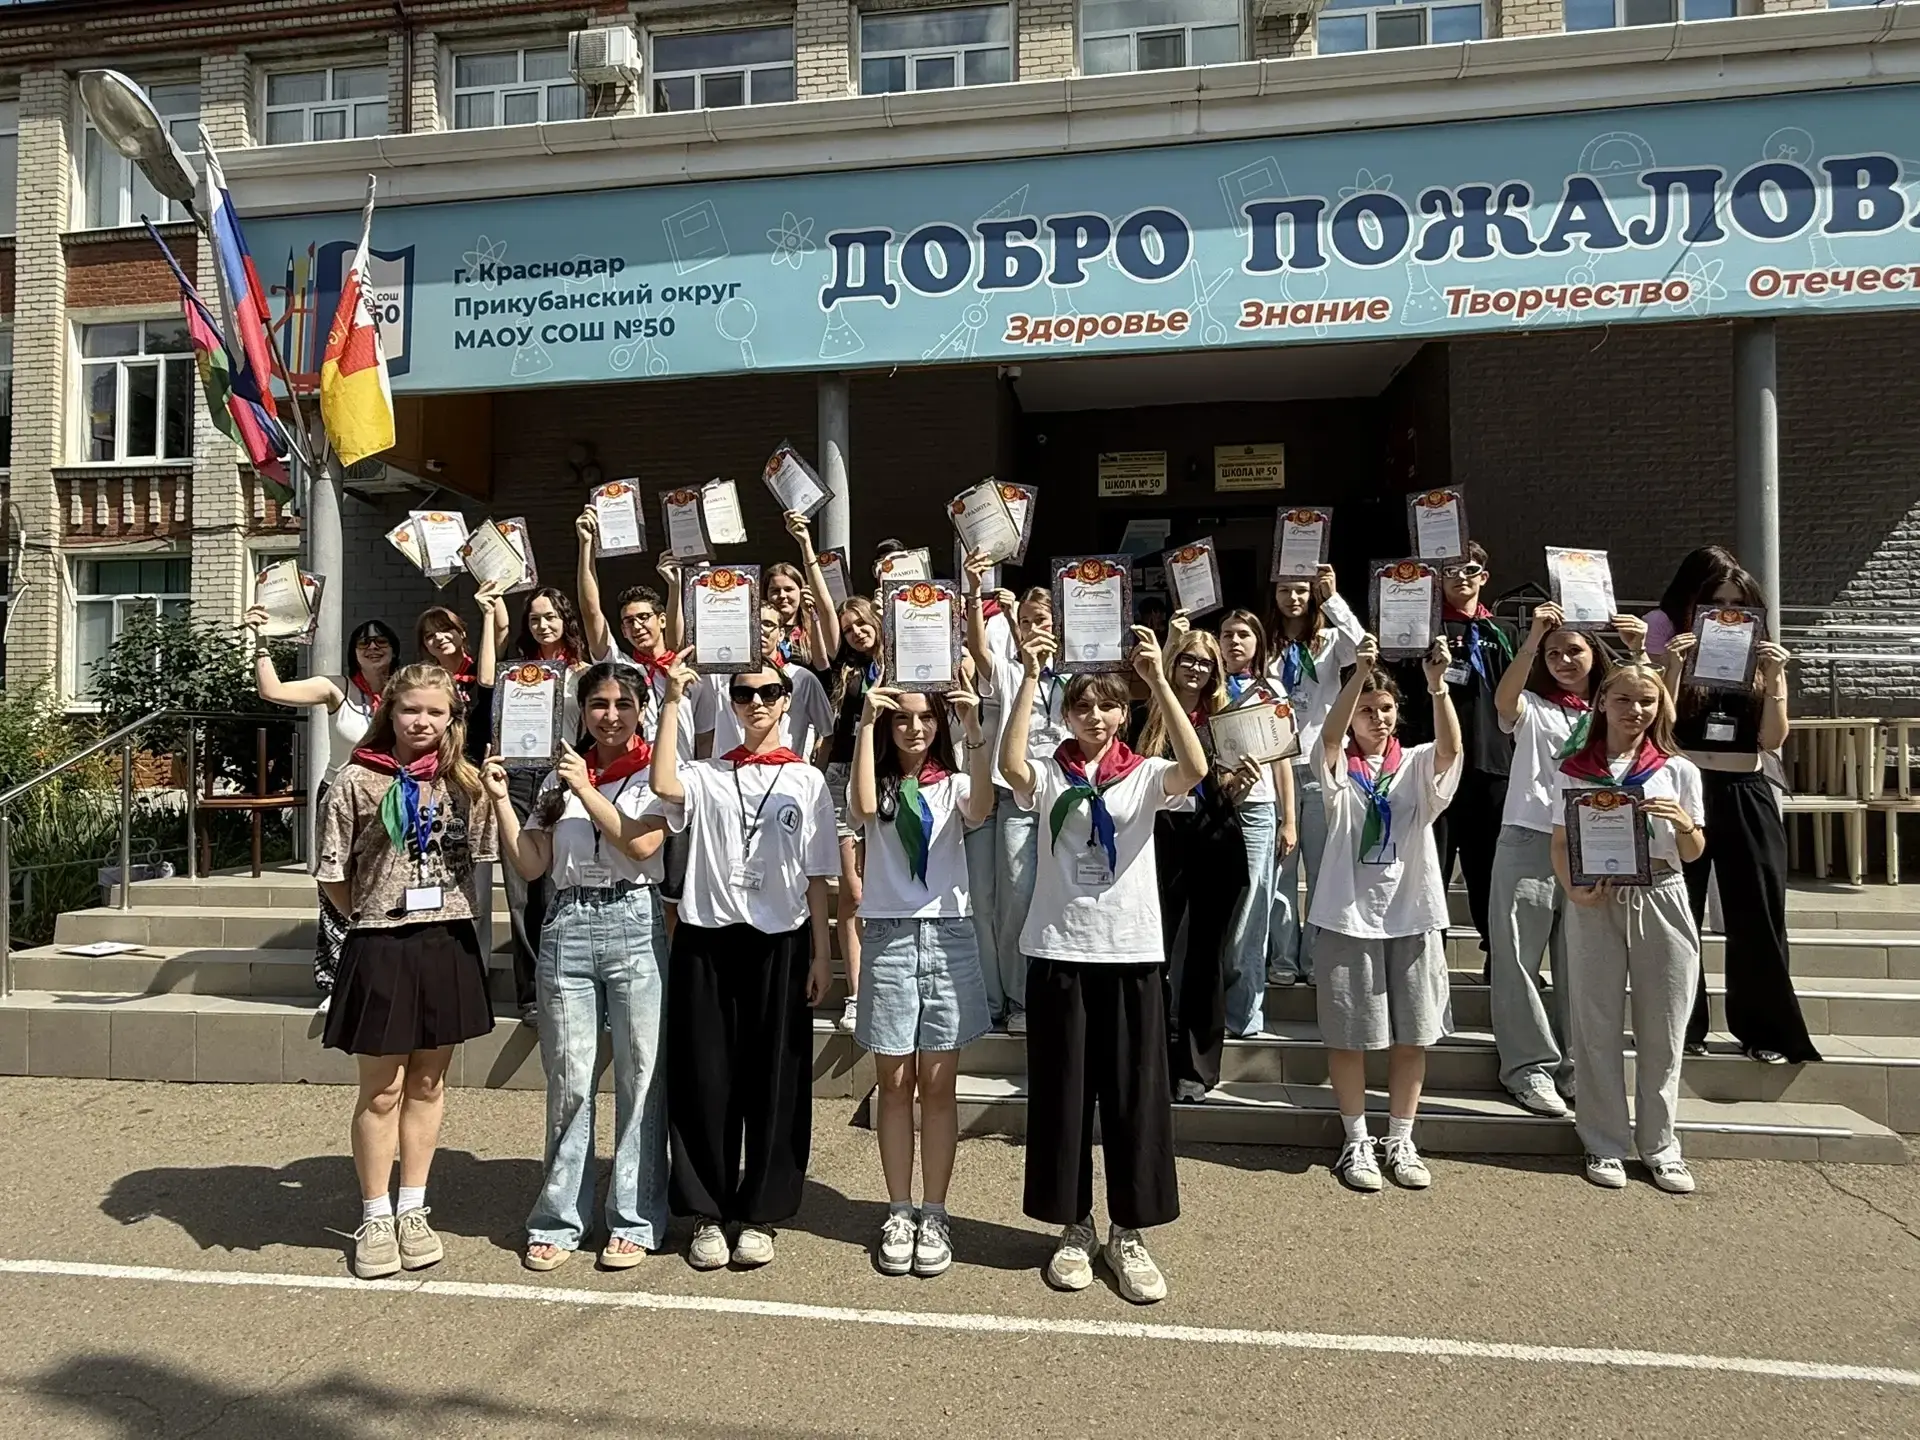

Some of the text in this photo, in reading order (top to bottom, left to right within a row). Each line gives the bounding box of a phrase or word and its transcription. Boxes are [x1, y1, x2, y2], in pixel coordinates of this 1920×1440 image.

[820, 154, 1920, 309] ДОБРО ПОЖАЛОВ
[453, 254, 626, 286] г. Краснодар
[453, 280, 742, 319] Прикубанский округ
[1240, 299, 1389, 328] Знание
[1447, 281, 1689, 318] Творчество
[453, 316, 675, 350] МАОУ СОШ №50
[1006, 311, 1189, 343] Здоровье
[1105, 479, 1136, 489] ШКОЛА
[1150, 478, 1160, 488] 50
[1222, 466, 1254, 478] ШКОЛА
[1267, 466, 1278, 475] 50
[890, 569, 919, 579] ГРАМОТА
